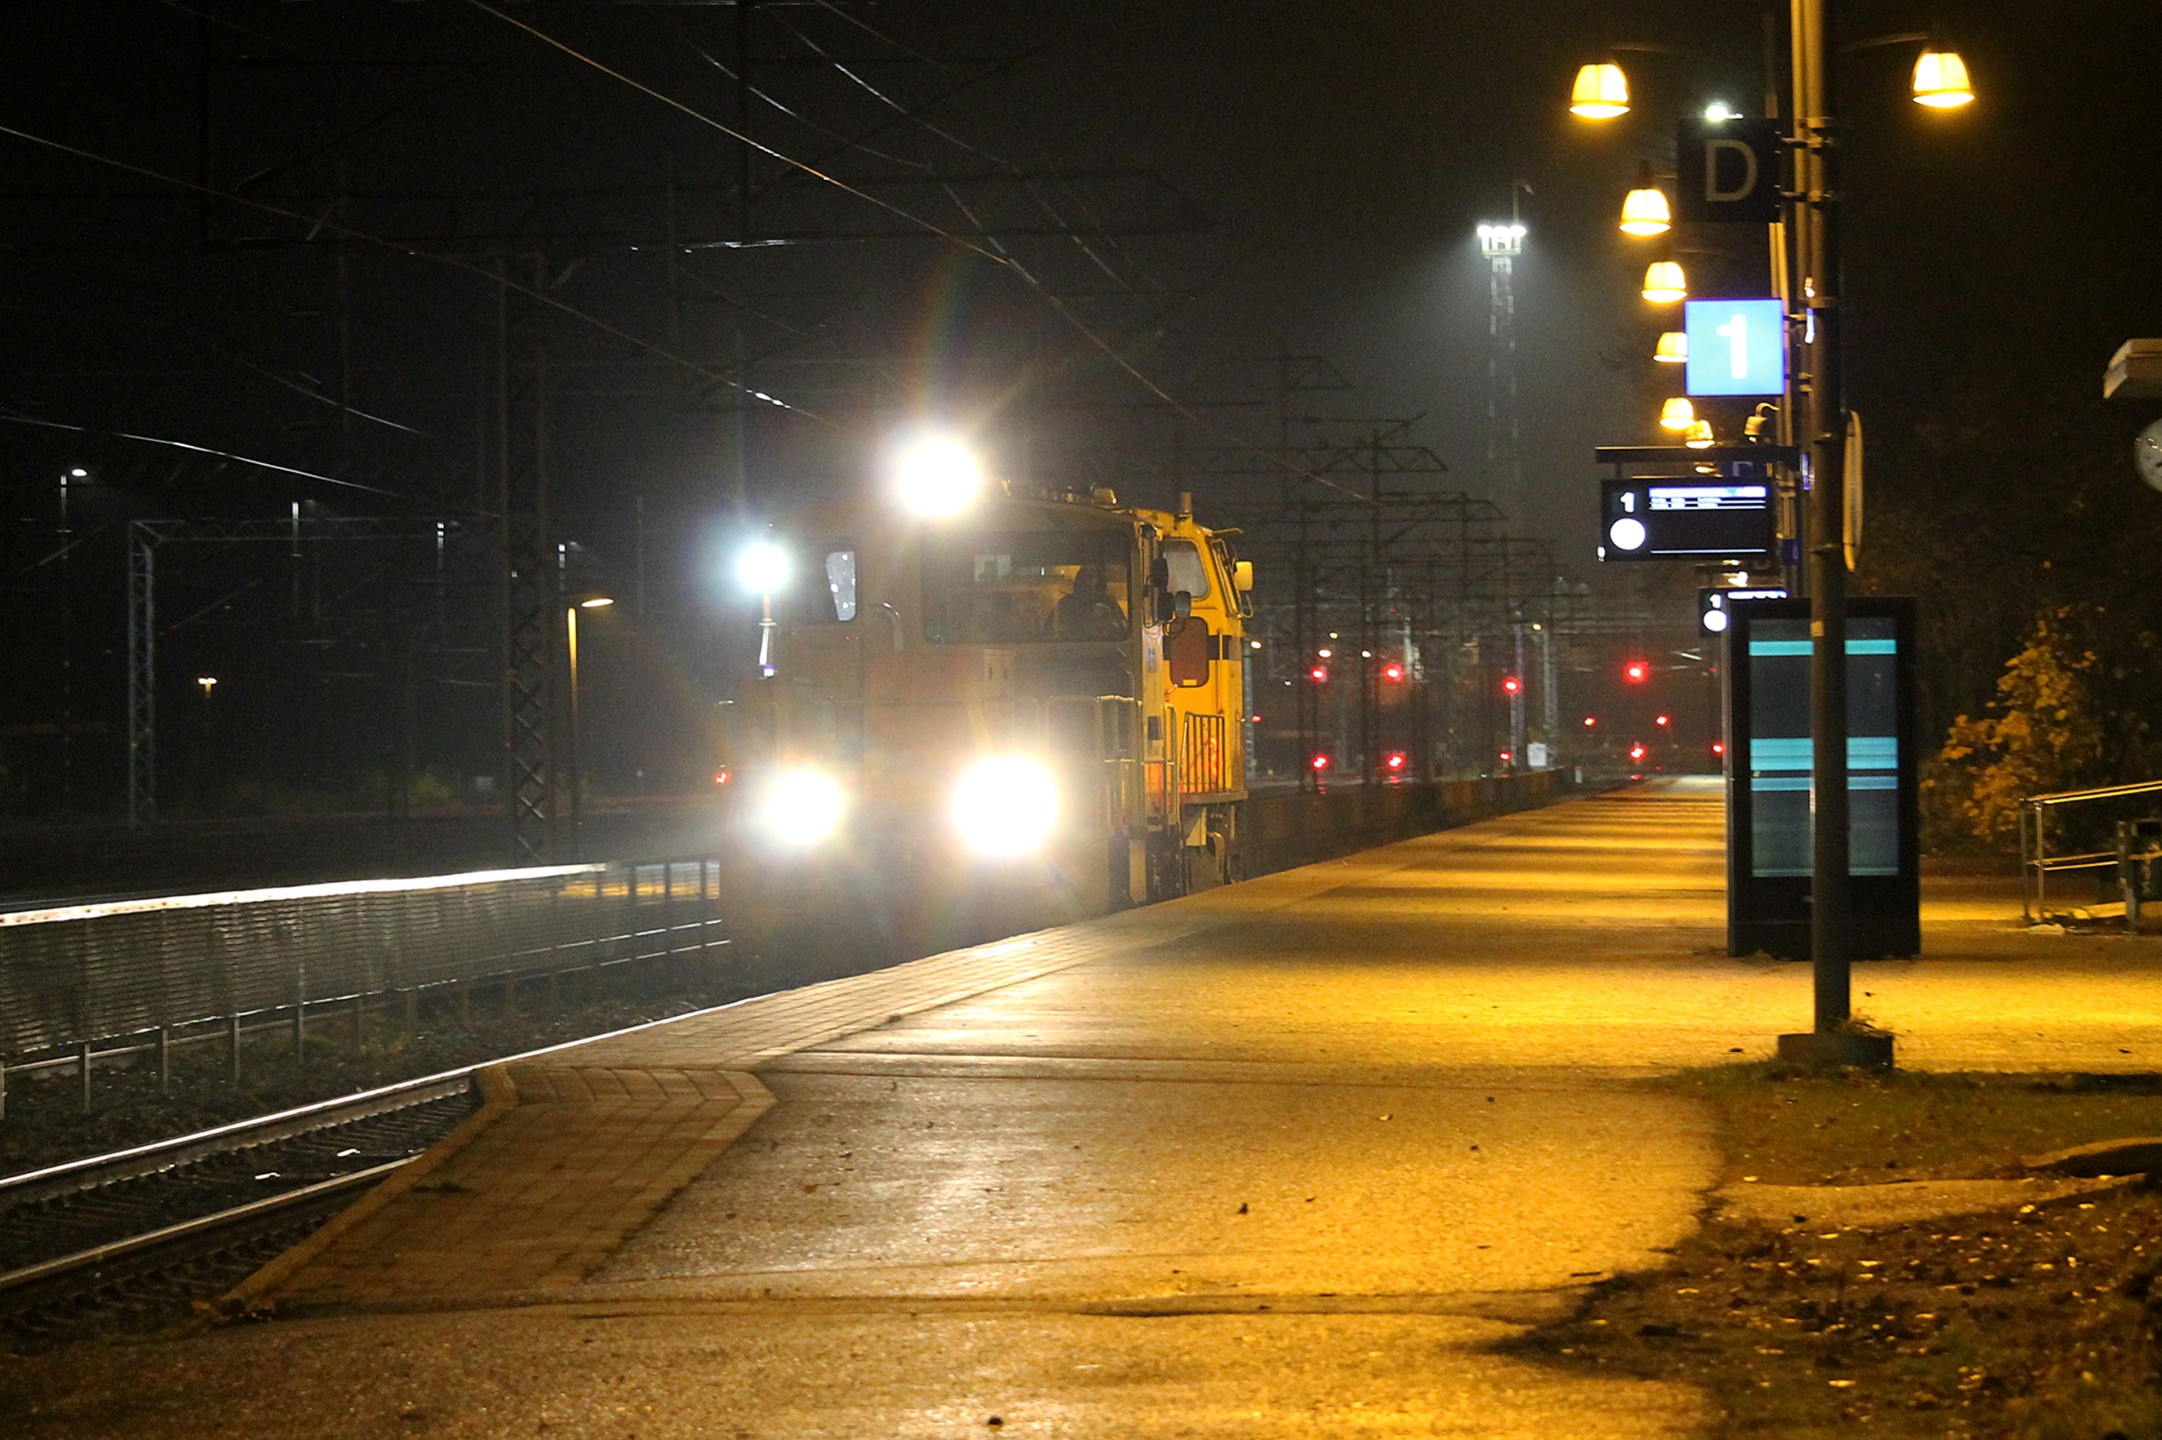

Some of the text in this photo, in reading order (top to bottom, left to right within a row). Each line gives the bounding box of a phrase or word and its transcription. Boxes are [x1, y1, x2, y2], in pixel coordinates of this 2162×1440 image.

[1706, 140, 1757, 201] D
[1716, 314, 1747, 379] 1
[1620, 492, 1634, 513] 1
[1710, 594, 1721, 608] 1
